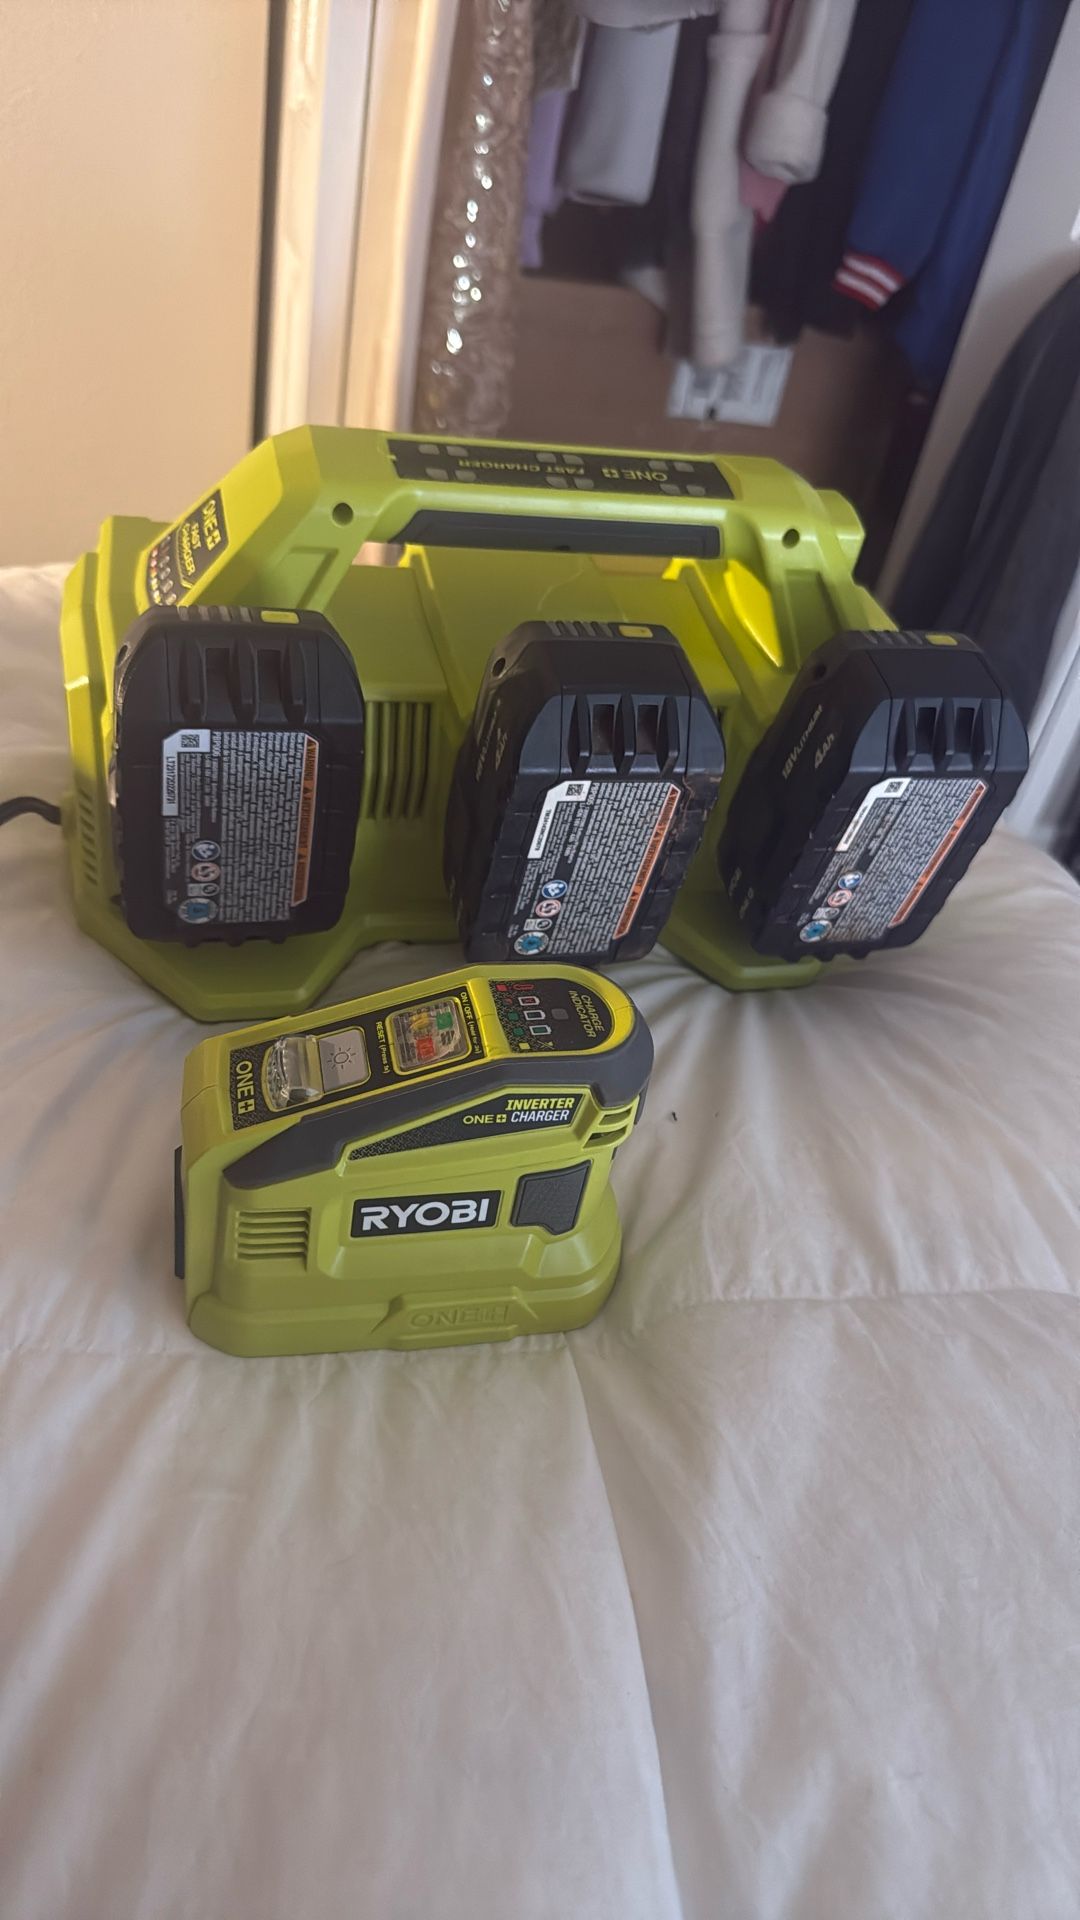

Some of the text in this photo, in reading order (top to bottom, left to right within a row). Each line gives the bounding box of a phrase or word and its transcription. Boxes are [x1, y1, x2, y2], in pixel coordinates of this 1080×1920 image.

[458, 459, 540, 472] CHARGER
[545, 464, 585, 475] FAST
[191, 522, 202, 549] FAST
[182, 523, 196, 576] CHARGER
[568, 990, 597, 1038] INDICATOR
[581, 994, 605, 1032] CHARGE
[376, 1021, 386, 1043] RESET
[505, 1097, 575, 1111] INVERTER
[510, 1109, 570, 1123] CHARGER
[360, 1198, 490, 1231] RYOBI
